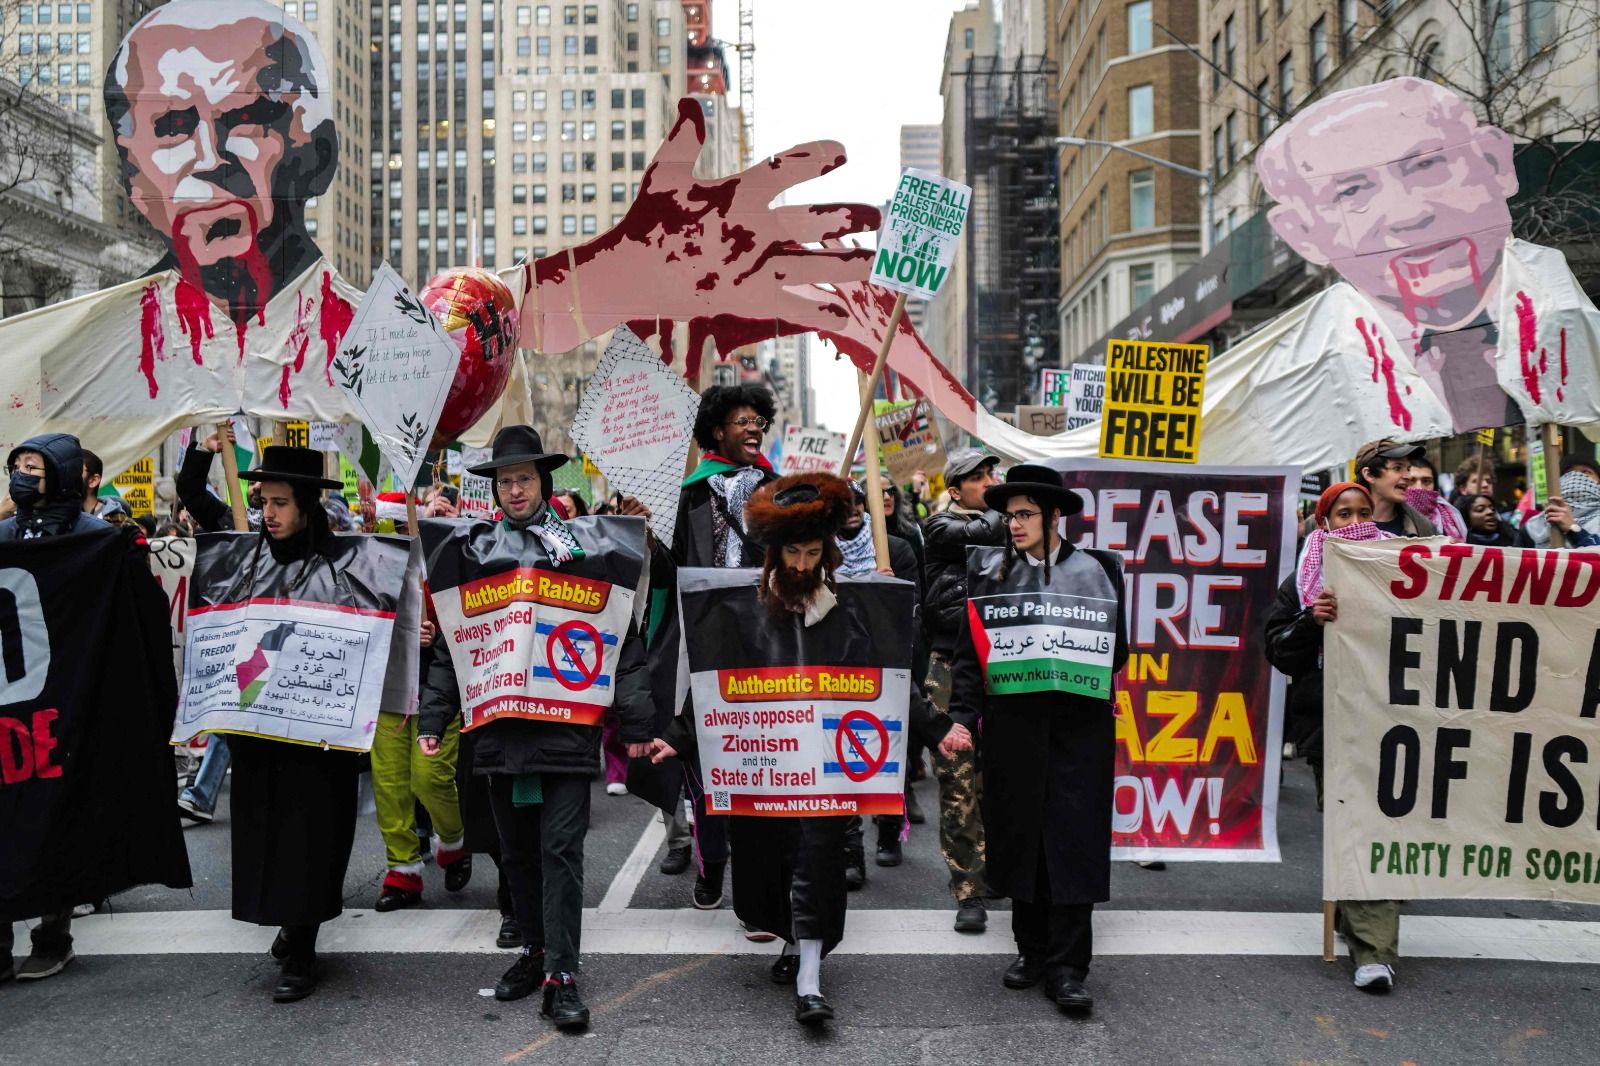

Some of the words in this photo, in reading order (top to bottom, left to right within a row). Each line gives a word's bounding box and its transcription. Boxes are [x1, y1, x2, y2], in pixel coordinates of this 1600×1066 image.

[899, 174, 941, 200] FREE
[940, 188, 966, 210] ALL
[895, 191, 965, 222] PALESTINIAN
[891, 203, 961, 236] PRISONERS
[875, 248, 947, 291] NOW
[381, 327, 387, 341] I
[390, 328, 405, 339] must
[407, 327, 418, 338] die
[369, 349, 380, 362] let
[383, 352, 390, 361] it
[413, 344, 431, 362] hope
[1111, 344, 1205, 374] PALESTINE
[365, 369, 377, 384] let
[380, 370, 386, 383] it
[389, 370, 398, 381] be
[403, 373, 409, 381] a
[413, 365, 431, 379] tale
[616, 377, 621, 386] I
[638, 371, 648, 380] die
[1045, 372, 1070, 393] FRE
[1111, 371, 1165, 405] WILL
[1171, 375, 1201, 407] BE
[875, 402, 931, 429] PALESTNA
[1076, 398, 1102, 413] YOUR
[1031, 412, 1066, 431] FRE
[1105, 408, 1197, 459] FREE!
[800, 437, 829, 454] FREE
[784, 454, 839, 471] PALESTINE
[1060, 488, 1268, 567] CEASE
[1390, 545, 1600, 607] STAND
[539, 577, 601, 606] Rabbis
[984, 604, 1019, 621] Free
[1023, 602, 1108, 622] Palestine
[1124, 573, 1242, 648] IRE
[454, 622, 491, 644] always
[993, 632, 1035, 657] عربية
[1042, 630, 1111, 655] فلسطين
[300, 642, 346, 661] الحرية
[205, 662, 226, 676] GAZA
[303, 662, 324, 675] غزة
[1128, 653, 1169, 682] IN
[1389, 617, 1539, 713] END
[189, 685, 203, 695] ALL
[277, 675, 333, 692] فلسطين
[336, 683, 355, 697] كل
[466, 683, 482, 702] State
[484, 679, 491, 694] of
[492, 669, 528, 690] Israel
[727, 674, 813, 695] Authentic
[819, 673, 875, 694] Rabbis
[991, 667, 1100, 691] www.nkusa.org
[483, 700, 571, 719] www.NKUSA.org
[704, 708, 750, 729] always
[753, 705, 814, 729] opposed
[1116, 690, 1258, 764] AZA
[722, 734, 799, 753] Zionism
[742, 756, 758, 766] and
[760, 756, 777, 766] the
[711, 768, 748, 786] State
[752, 769, 764, 786] of
[770, 768, 816, 786] Israel
[1378, 725, 1471, 819] OF
[1505, 732, 1600, 831] IS
[754, 799, 857, 811] www.NKUSA.org
[1112, 776, 1224, 836] OW!
[1370, 842, 1451, 877] PARTY
[1463, 845, 1512, 877] FOR
